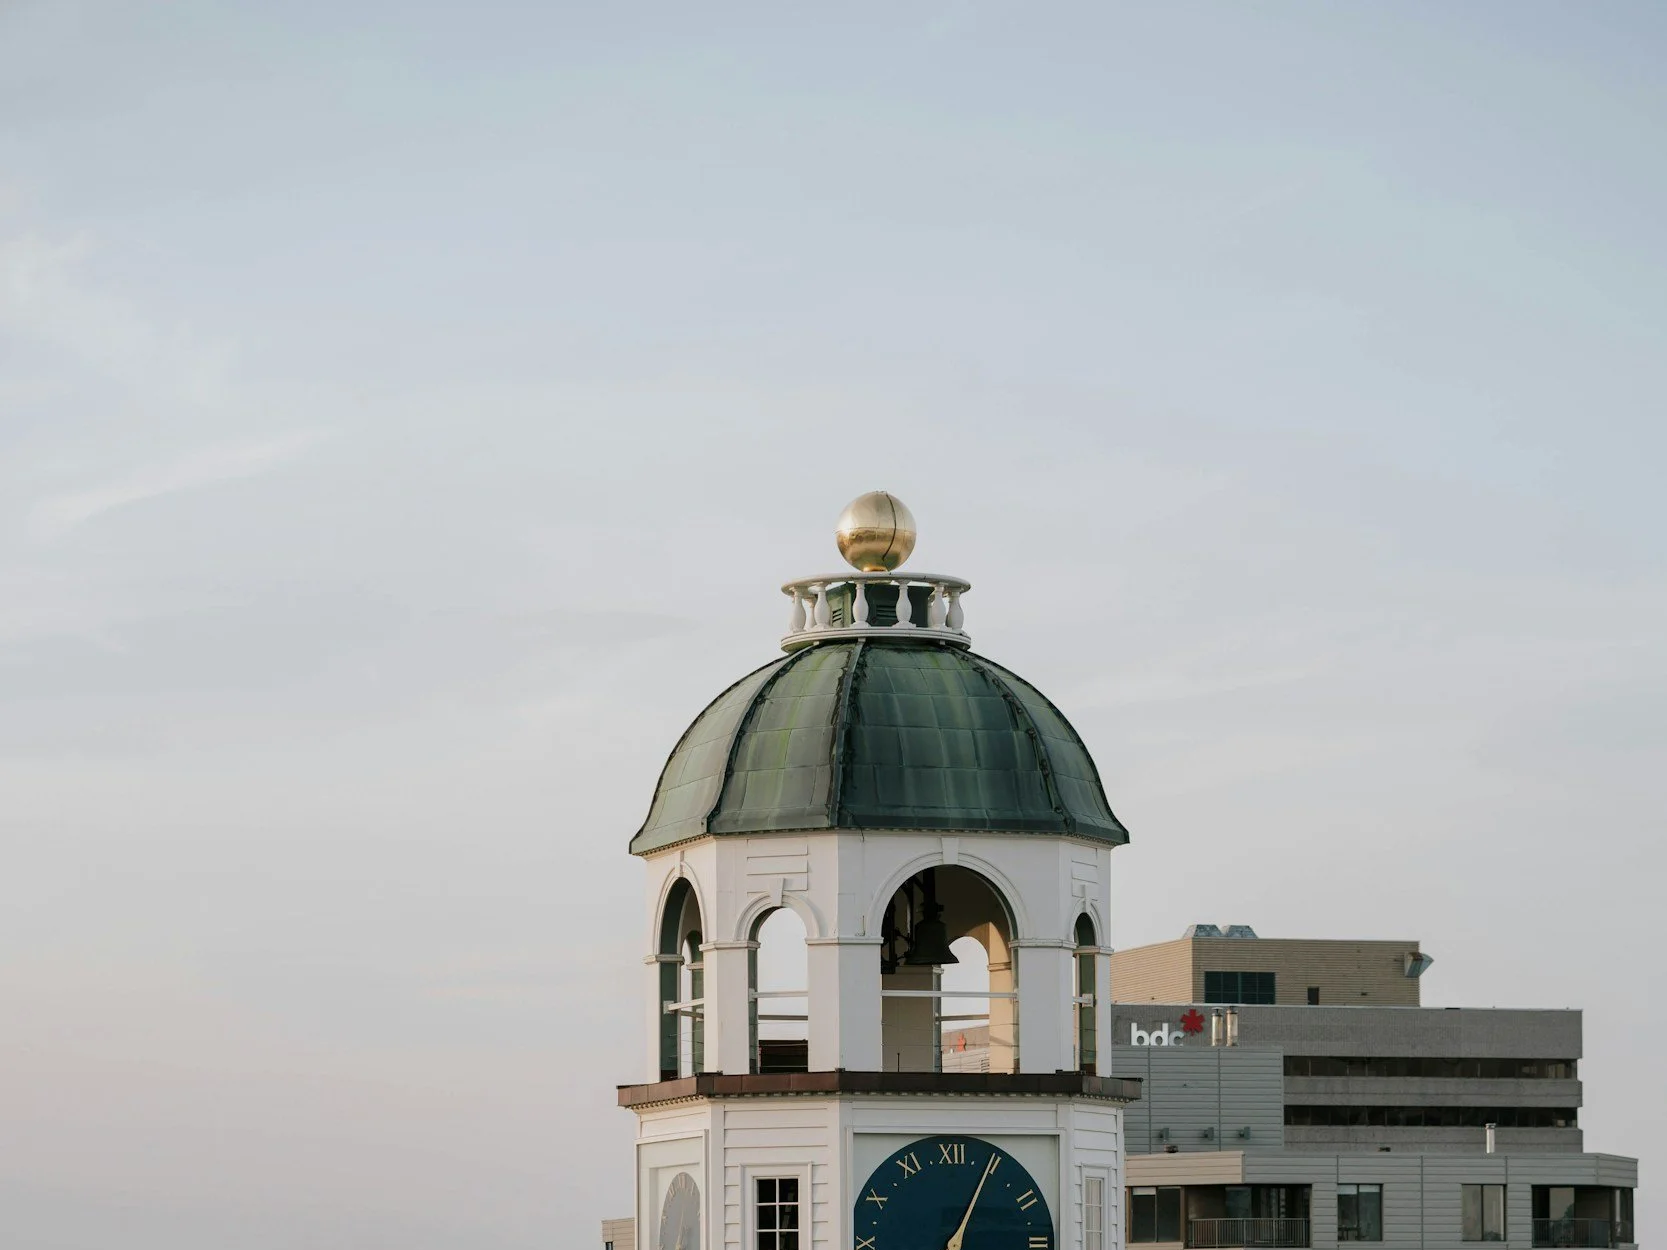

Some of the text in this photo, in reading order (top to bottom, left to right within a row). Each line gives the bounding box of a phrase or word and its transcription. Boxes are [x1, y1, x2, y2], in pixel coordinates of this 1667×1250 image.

[1131, 1022, 1185, 1046] bdc
[939, 1144, 965, 1164] XII
[896, 1152, 922, 1179] XI
[865, 1188, 888, 1210] X
[1016, 1189, 1038, 1211] II
